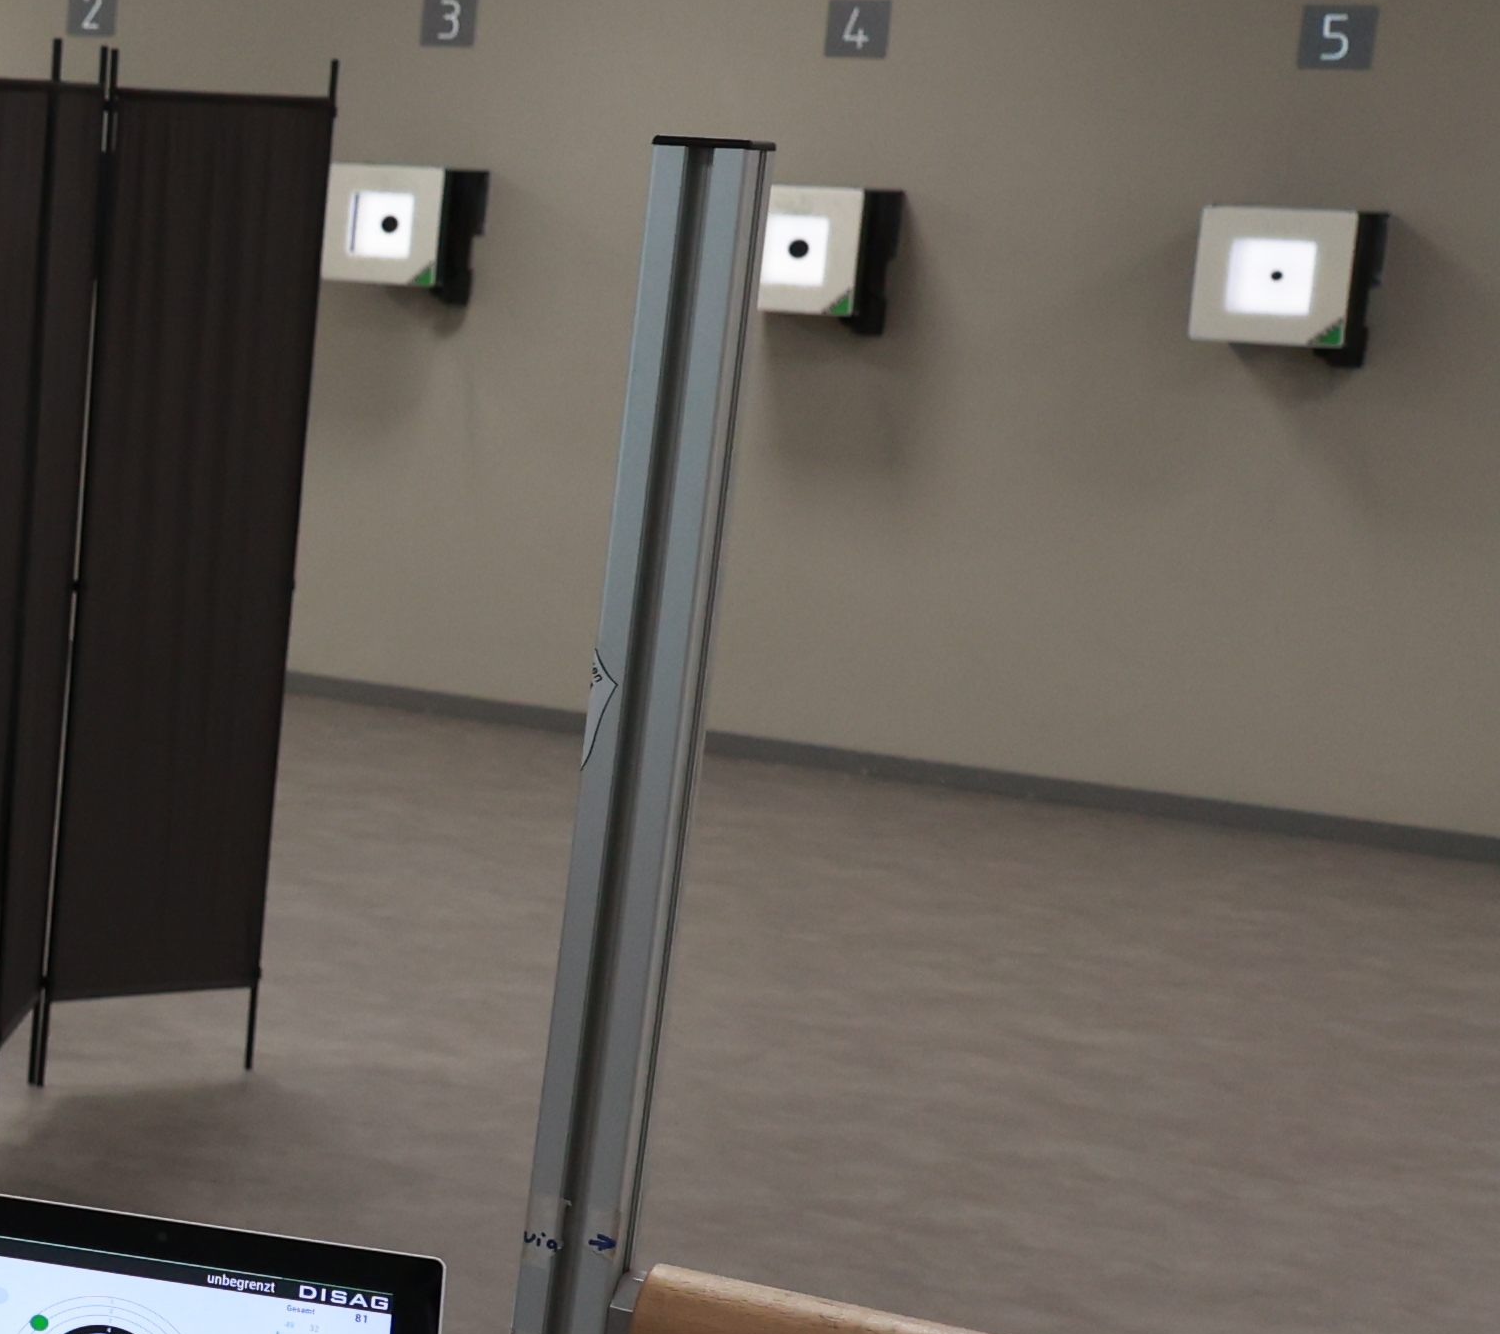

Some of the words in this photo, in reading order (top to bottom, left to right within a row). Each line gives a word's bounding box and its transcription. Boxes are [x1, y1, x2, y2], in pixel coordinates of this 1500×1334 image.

[842, 6, 868, 49] 4
[1320, 12, 1349, 61] 5
[206, 1273, 277, 1294] unbegrenzt
[298, 1284, 390, 1310] DISAG
[309, 1324, 320, 1333] 32
[355, 1313, 368, 1324] 81
